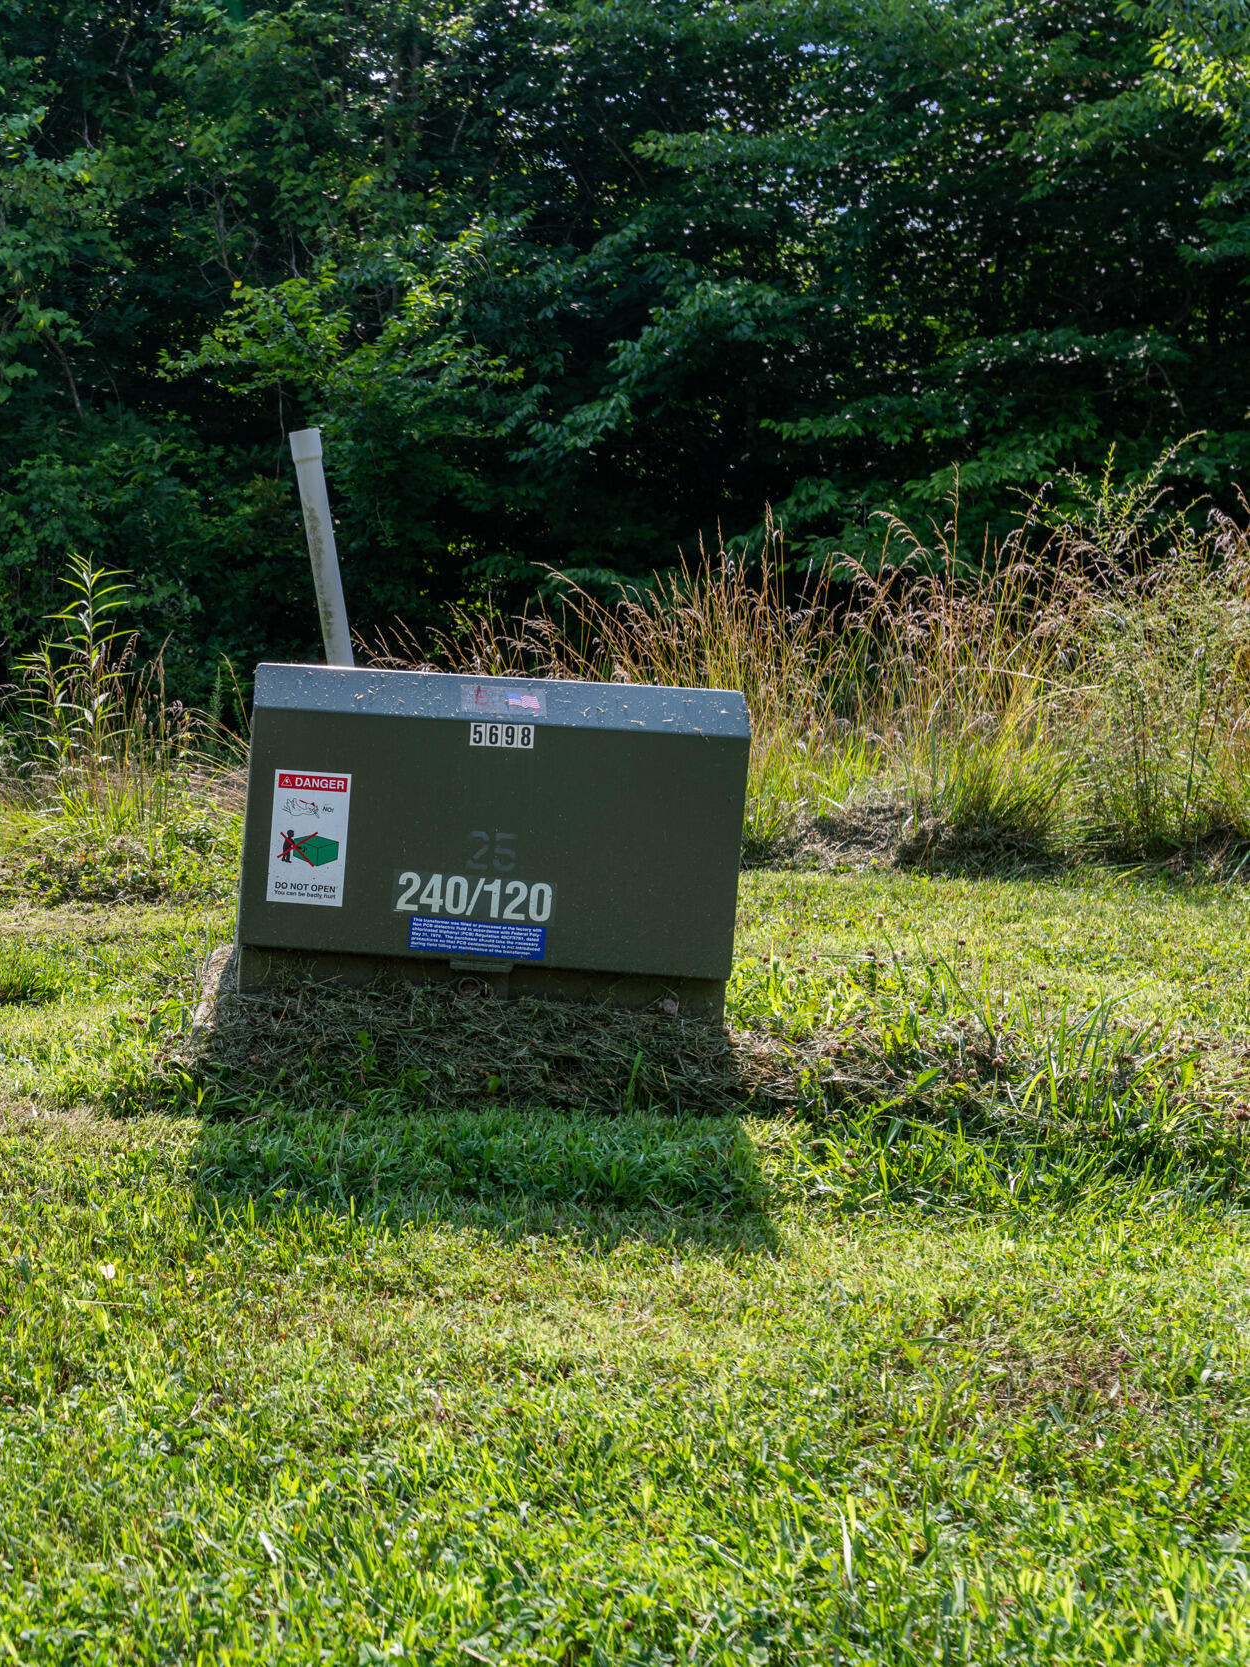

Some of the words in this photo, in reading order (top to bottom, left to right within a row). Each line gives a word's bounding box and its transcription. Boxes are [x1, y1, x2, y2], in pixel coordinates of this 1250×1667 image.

[472, 725, 531, 746] 5698
[294, 777, 345, 790] DANGER
[465, 831, 518, 871] 25
[275, 881, 288, 889] DO
[290, 883, 310, 891] NOT
[311, 884, 336, 893] OPEN
[396, 871, 552, 922] 240/120
